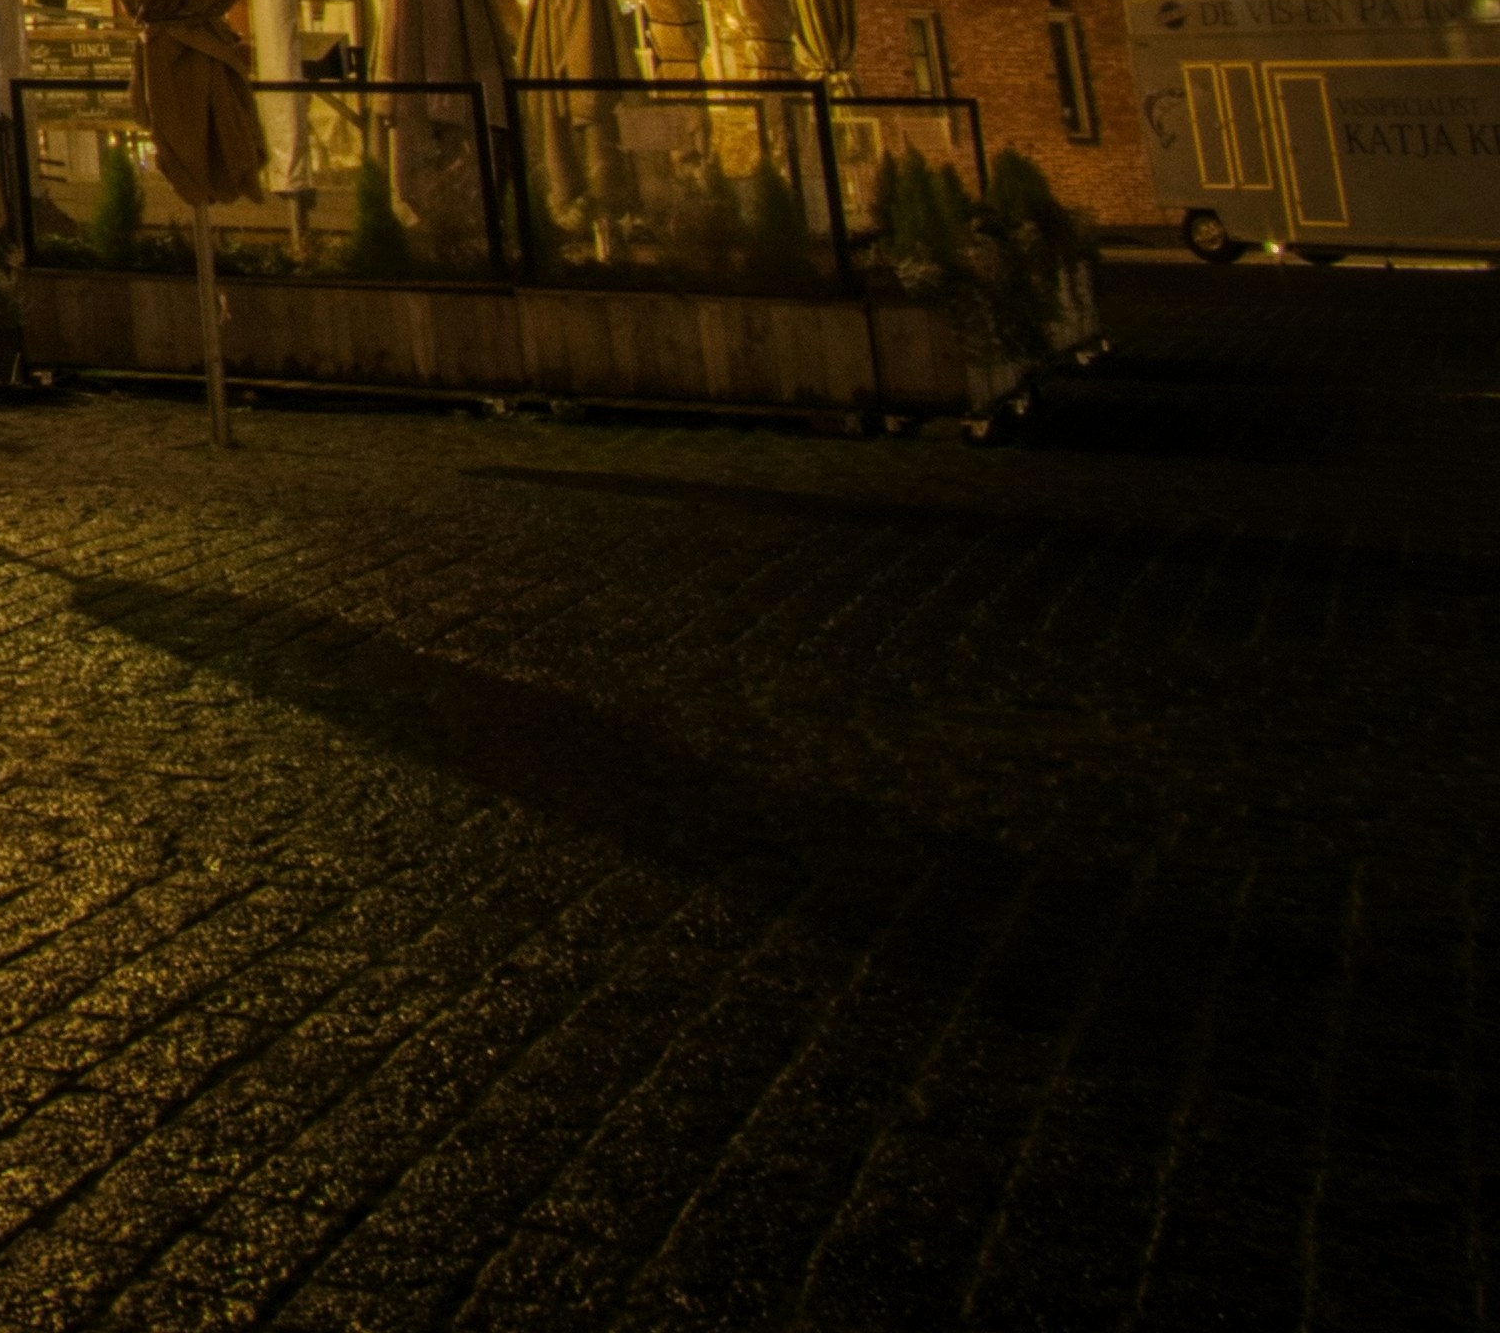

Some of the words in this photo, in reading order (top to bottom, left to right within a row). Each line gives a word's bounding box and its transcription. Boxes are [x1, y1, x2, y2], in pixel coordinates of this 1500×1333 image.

[1200, 0, 1238, 27] DE
[70, 42, 111, 58] LUNCH
[1343, 122, 1457, 159] KATJA
